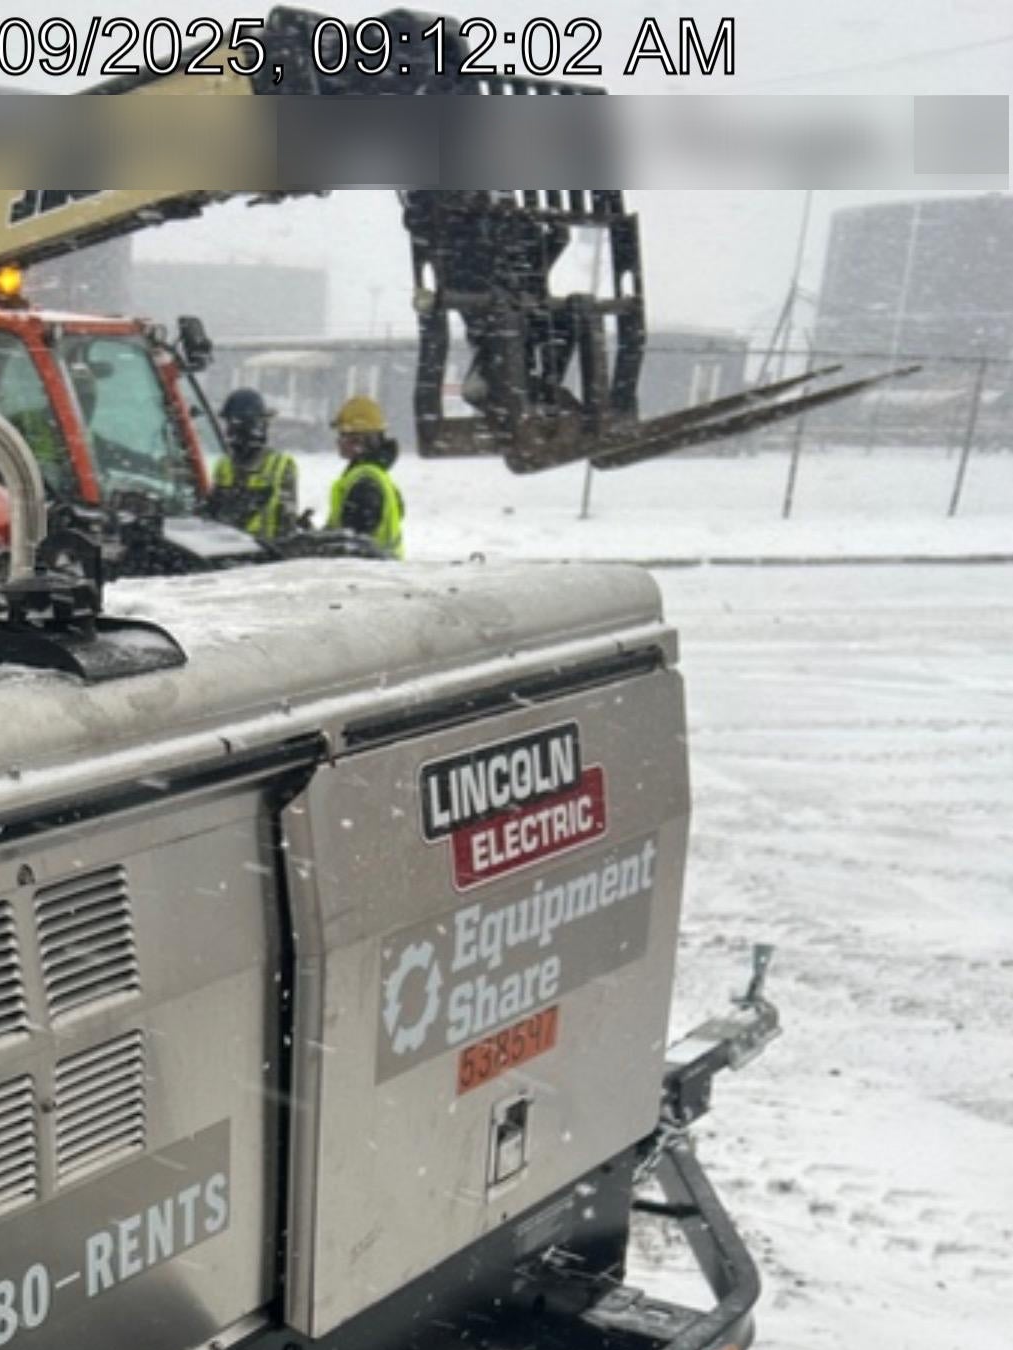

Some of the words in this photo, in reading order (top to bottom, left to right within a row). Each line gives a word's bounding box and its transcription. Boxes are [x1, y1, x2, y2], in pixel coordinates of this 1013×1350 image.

[428, 734, 576, 830] LINCOLN
[471, 795, 594, 873] ELECTRIC
[451, 838, 657, 974] Equipment
[446, 954, 562, 1047] Share
